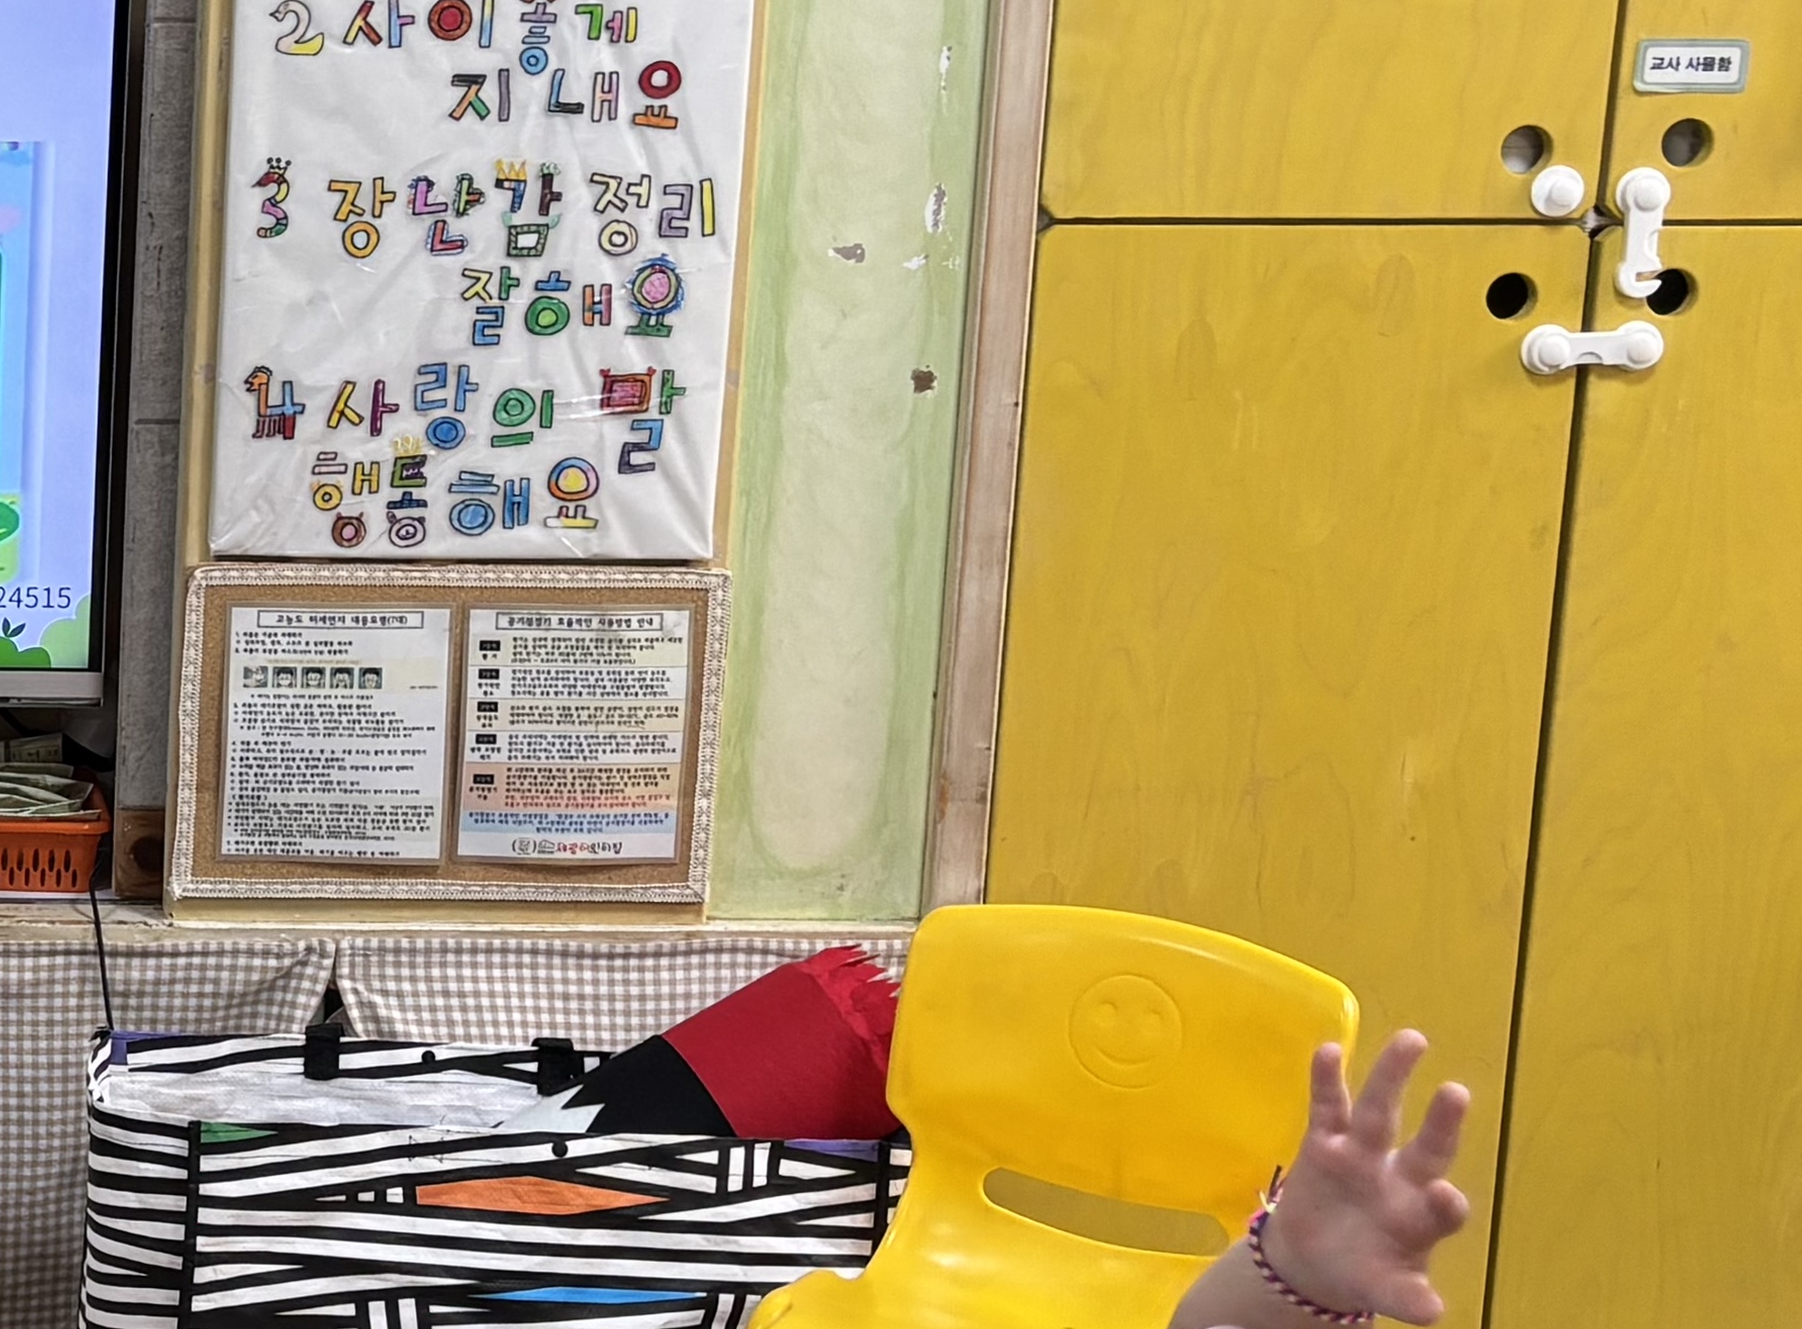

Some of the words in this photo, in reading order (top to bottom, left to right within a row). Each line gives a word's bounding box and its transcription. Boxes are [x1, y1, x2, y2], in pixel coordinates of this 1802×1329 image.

[448, 59, 682, 129] 지내요
[1649, 56, 1681, 71] 교사
[1685, 56, 1732, 72] 사물함
[460, 254, 685, 346] 잘해요
[326, 361, 555, 450] 사랑의
[598, 366, 687, 474] 말
